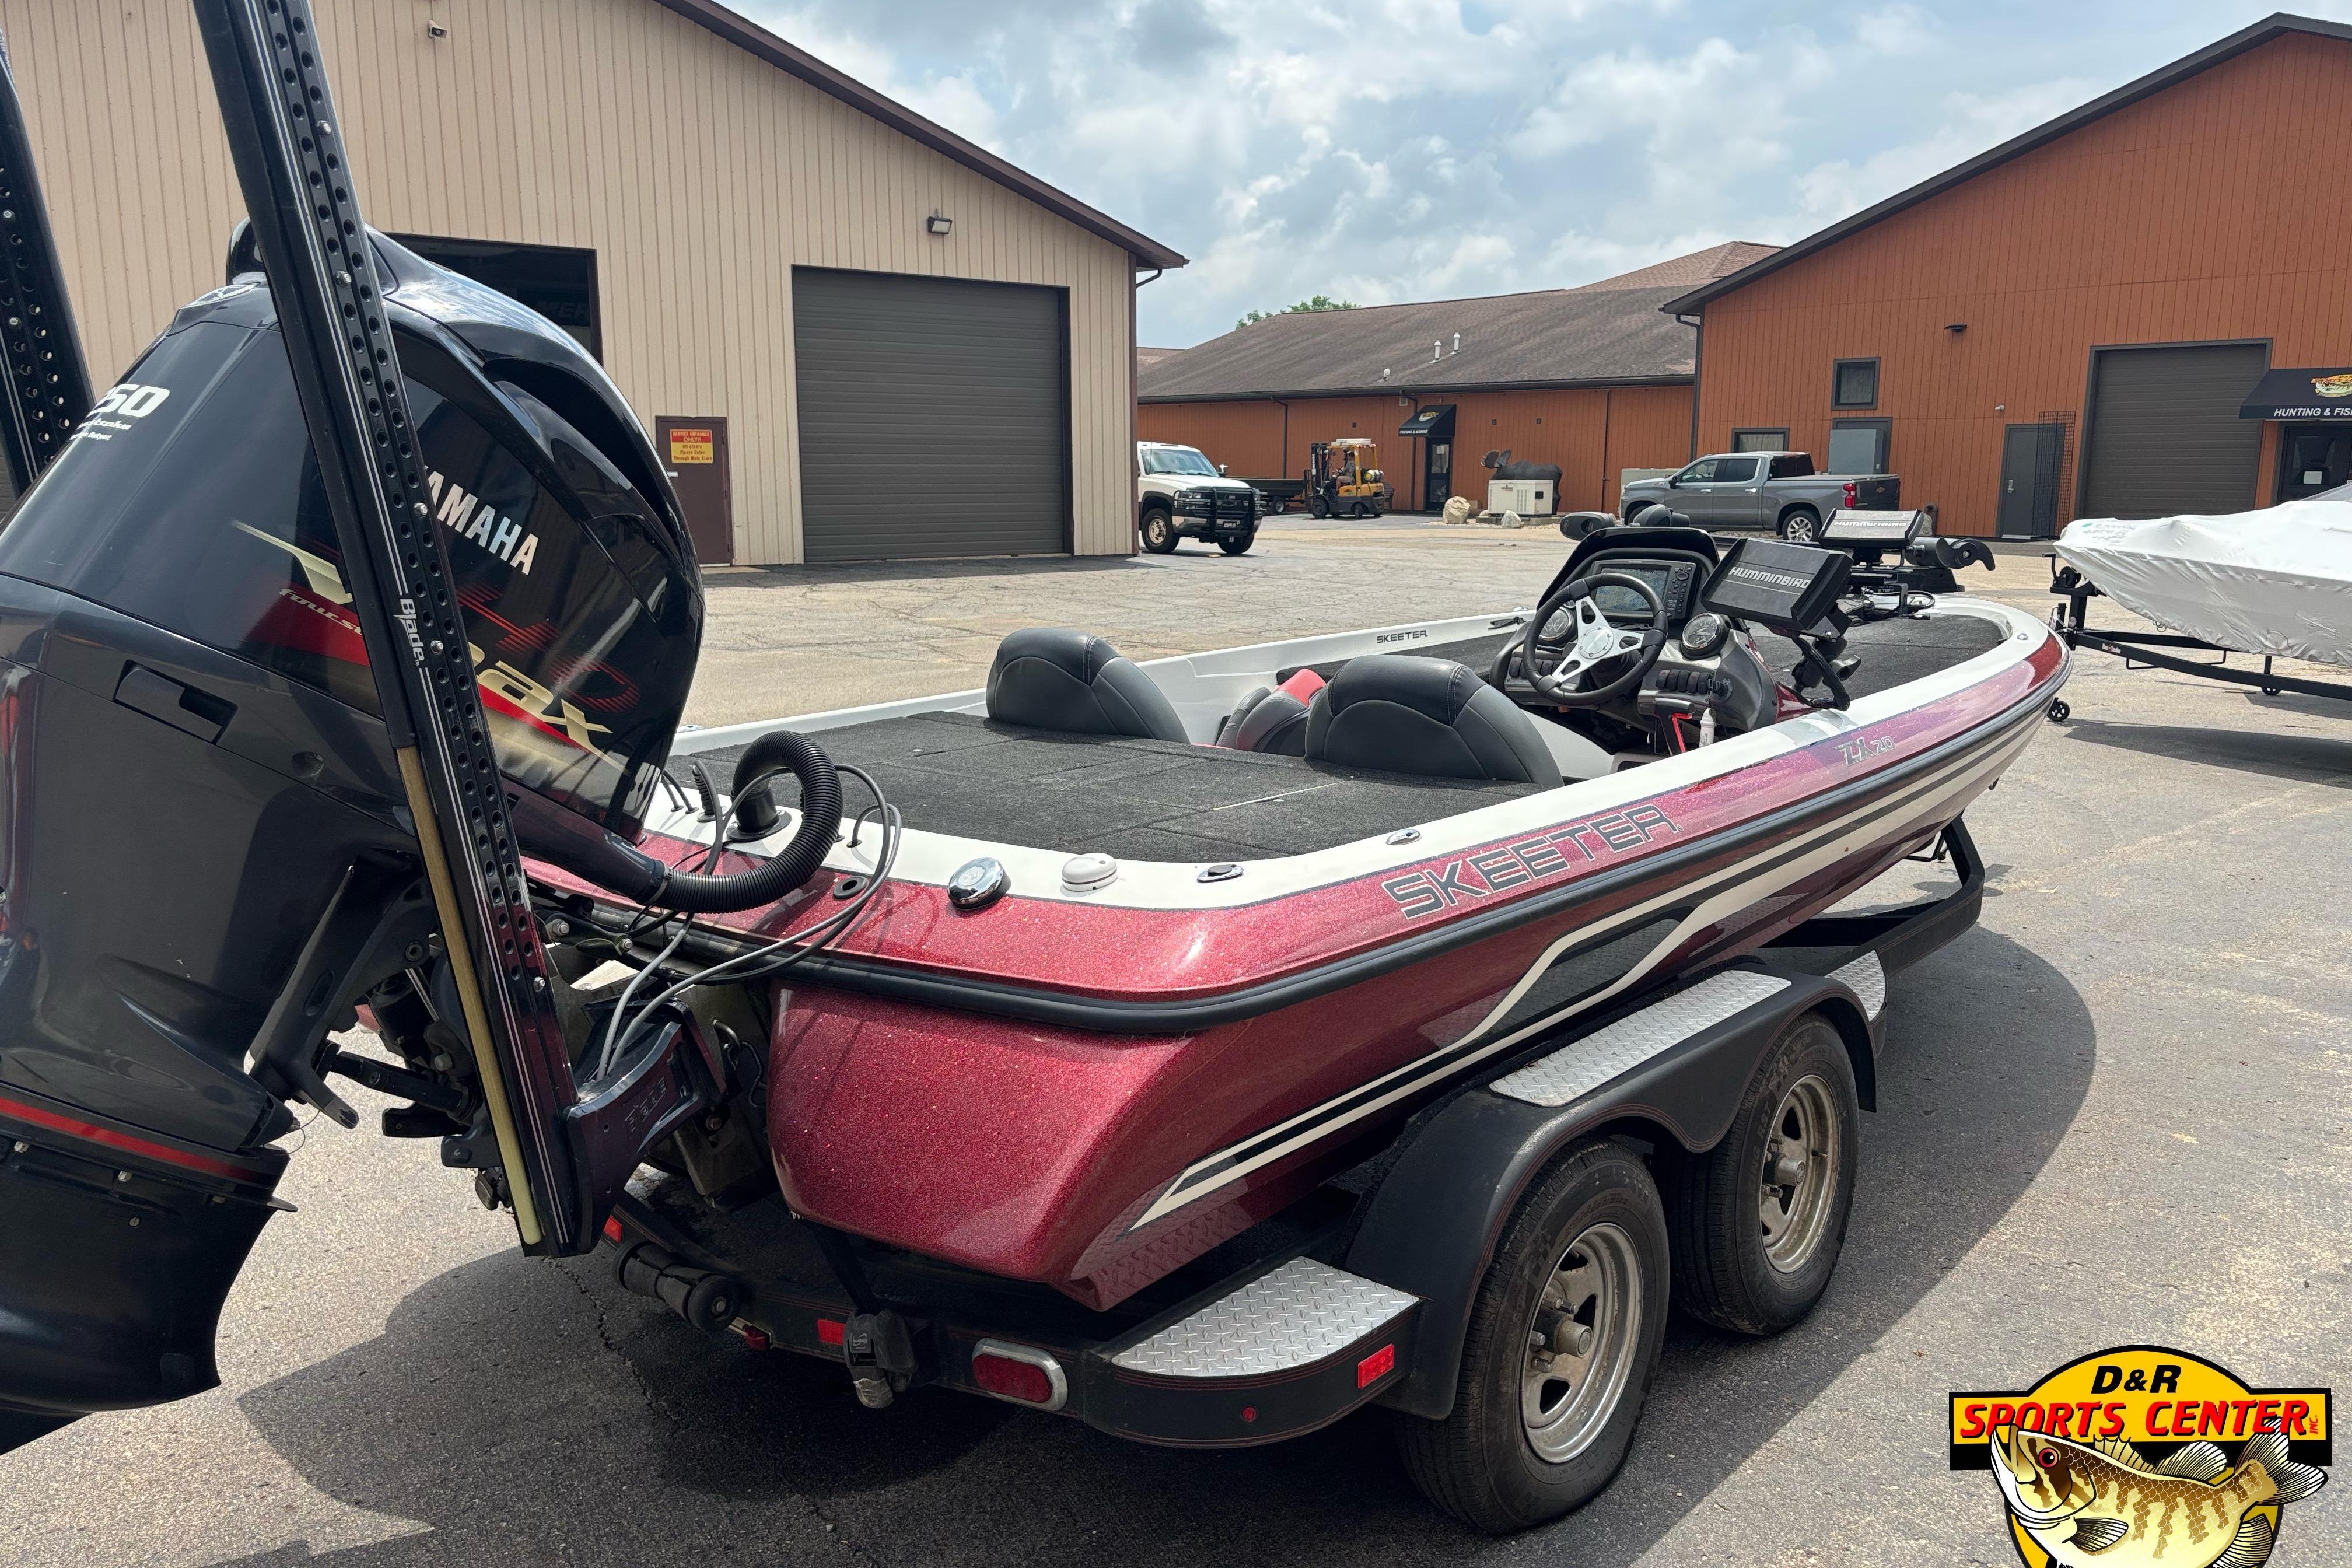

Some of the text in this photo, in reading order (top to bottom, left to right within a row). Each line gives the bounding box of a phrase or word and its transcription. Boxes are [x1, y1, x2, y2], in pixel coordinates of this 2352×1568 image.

[86, 383, 170, 417] 50
[2273, 407, 2352, 416] HUNTING & FIS
[425, 465, 539, 576] AMAHA
[1728, 566, 1811, 589] HUMMINBIRD
[393, 598, 425, 661] Blade
[1377, 629, 1427, 643] SKEETER
[1381, 804, 1680, 920] SKEETER
